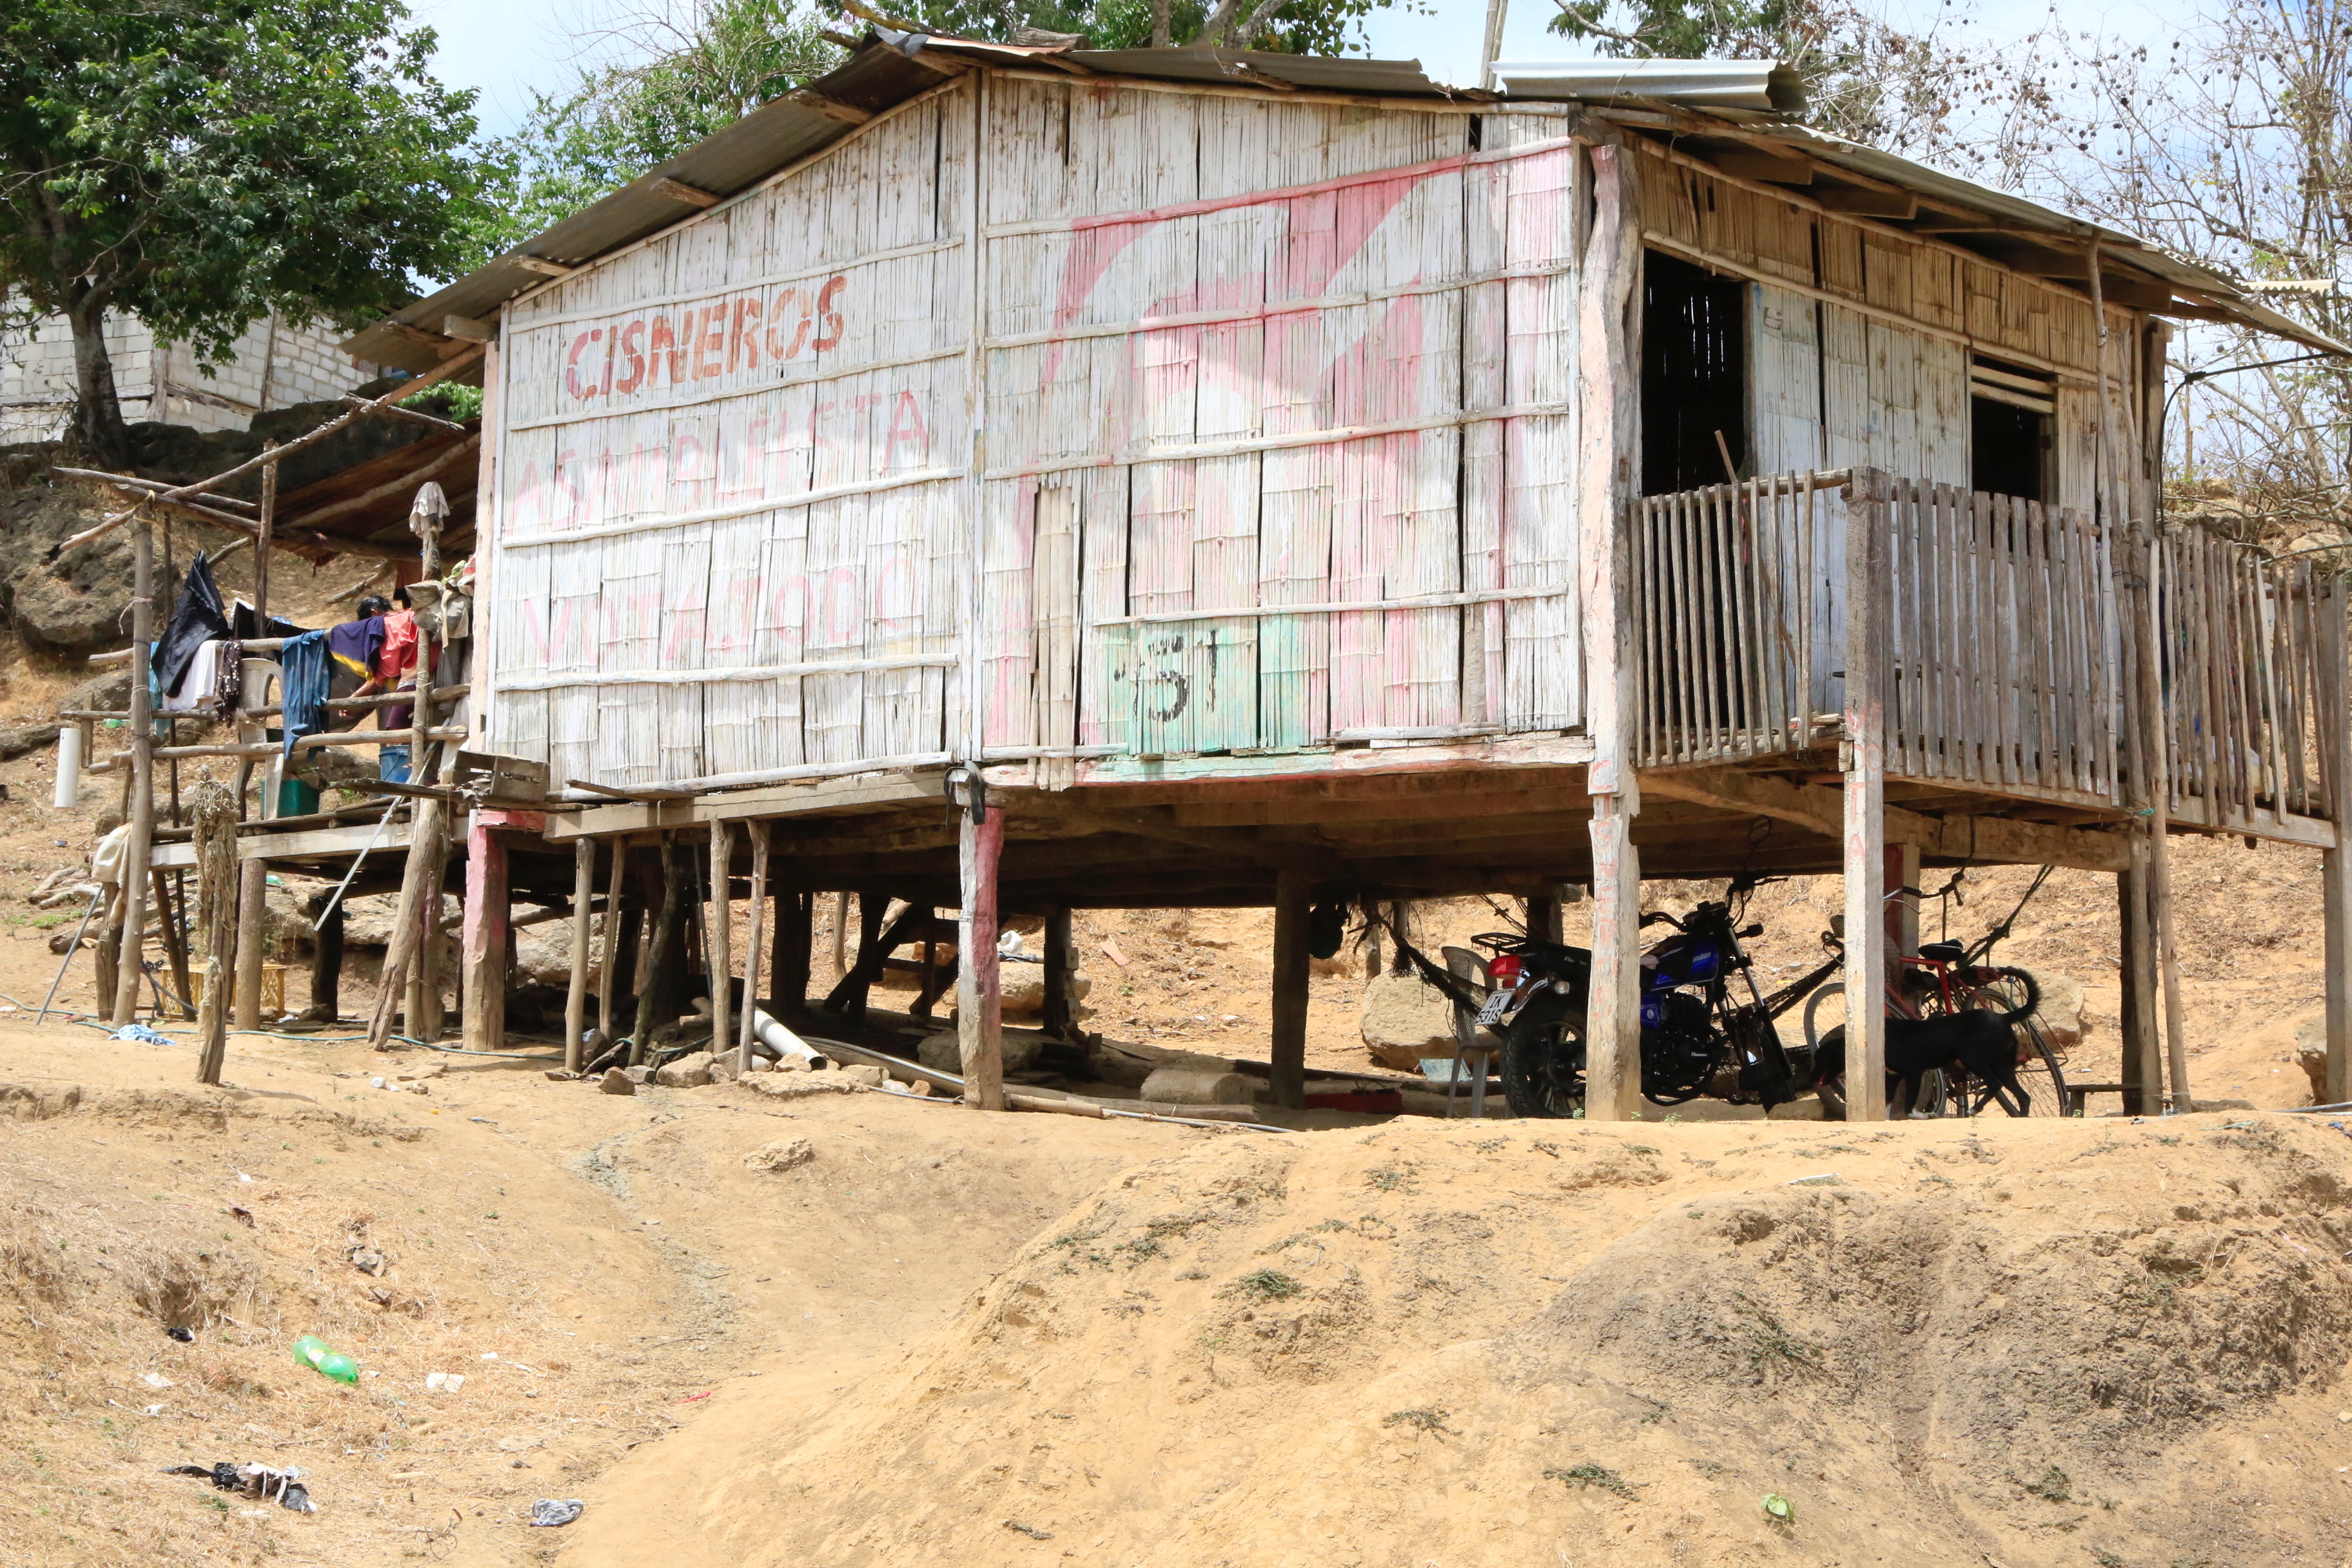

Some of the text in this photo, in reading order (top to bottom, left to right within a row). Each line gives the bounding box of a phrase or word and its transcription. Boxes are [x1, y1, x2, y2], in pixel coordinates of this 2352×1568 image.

[566, 275, 847, 400] CISNEROS
[505, 389, 930, 534] ASAMBLEISTA
[1489, 994, 1505, 1008] IK
